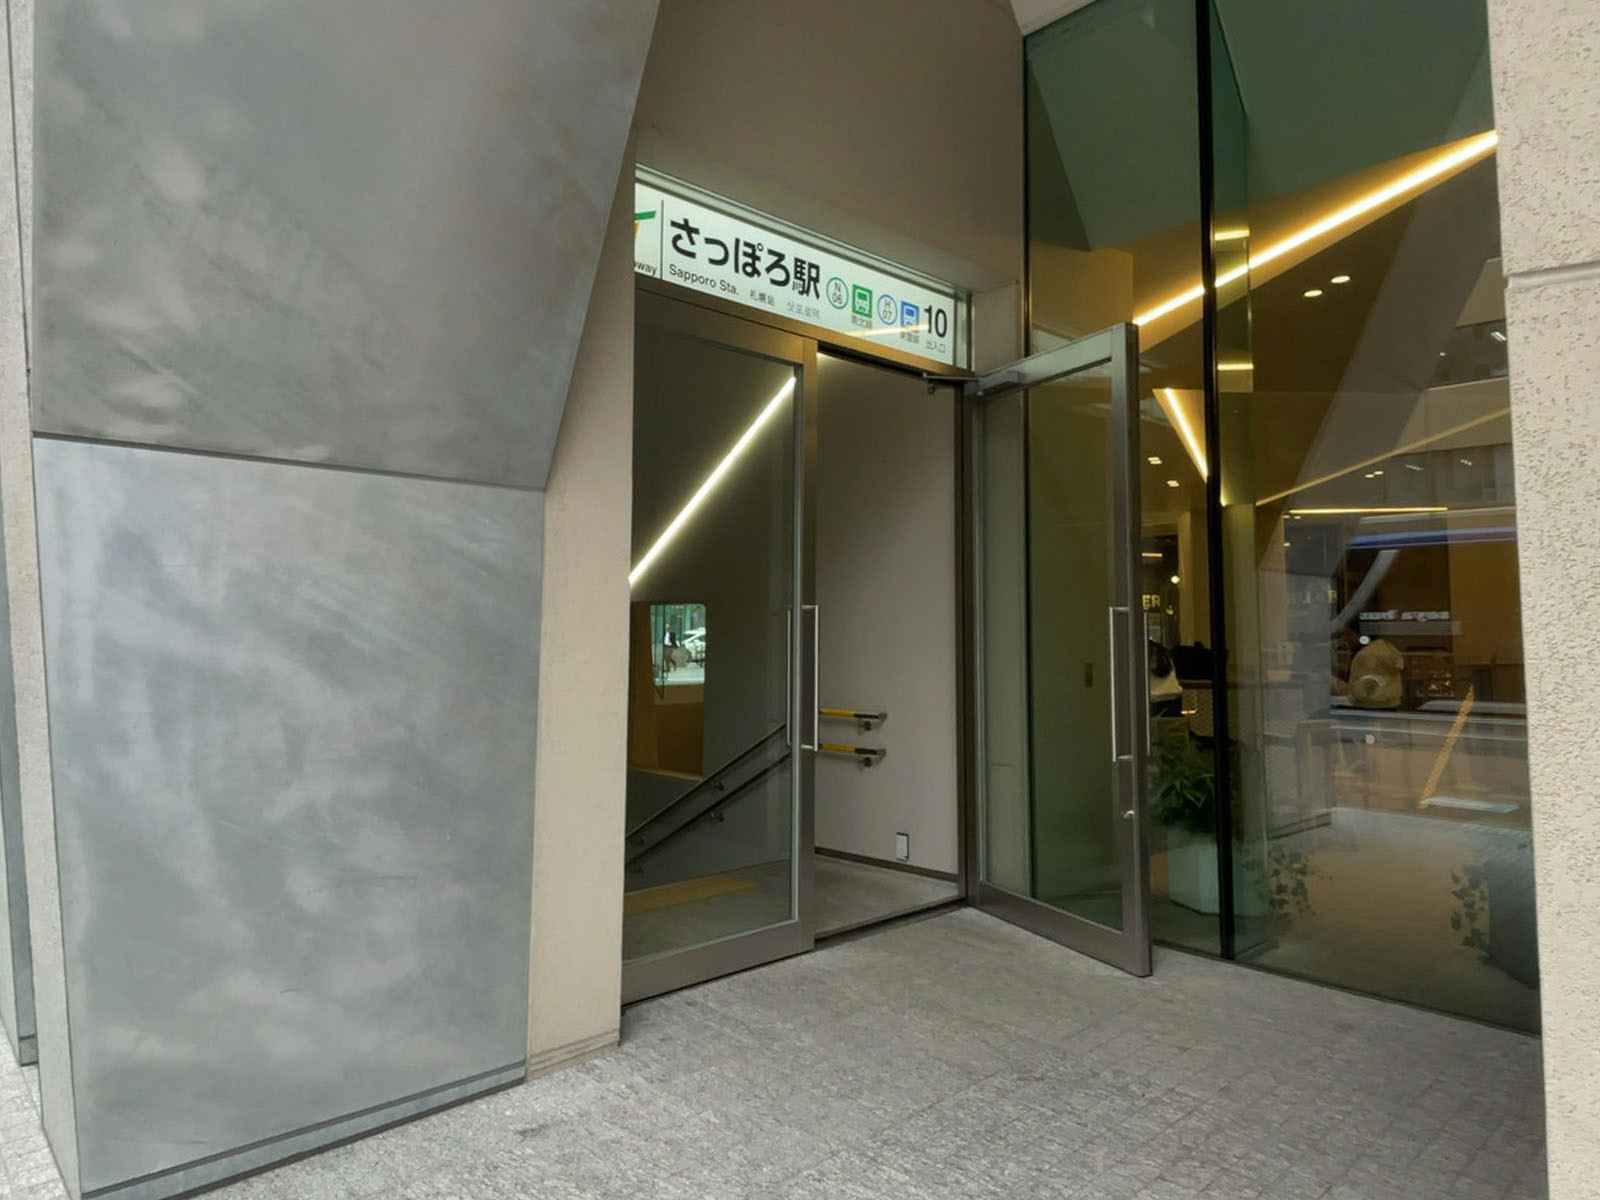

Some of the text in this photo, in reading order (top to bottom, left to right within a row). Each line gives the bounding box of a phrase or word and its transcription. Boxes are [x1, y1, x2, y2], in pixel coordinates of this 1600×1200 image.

[670, 218, 820, 300] さっぽろ駅
[669, 264, 739, 296] Sapporo Sta.
[832, 293, 843, 305] 06
[884, 301, 891, 310] H
[882, 312, 893, 323] 07
[924, 305, 948, 338] 10
